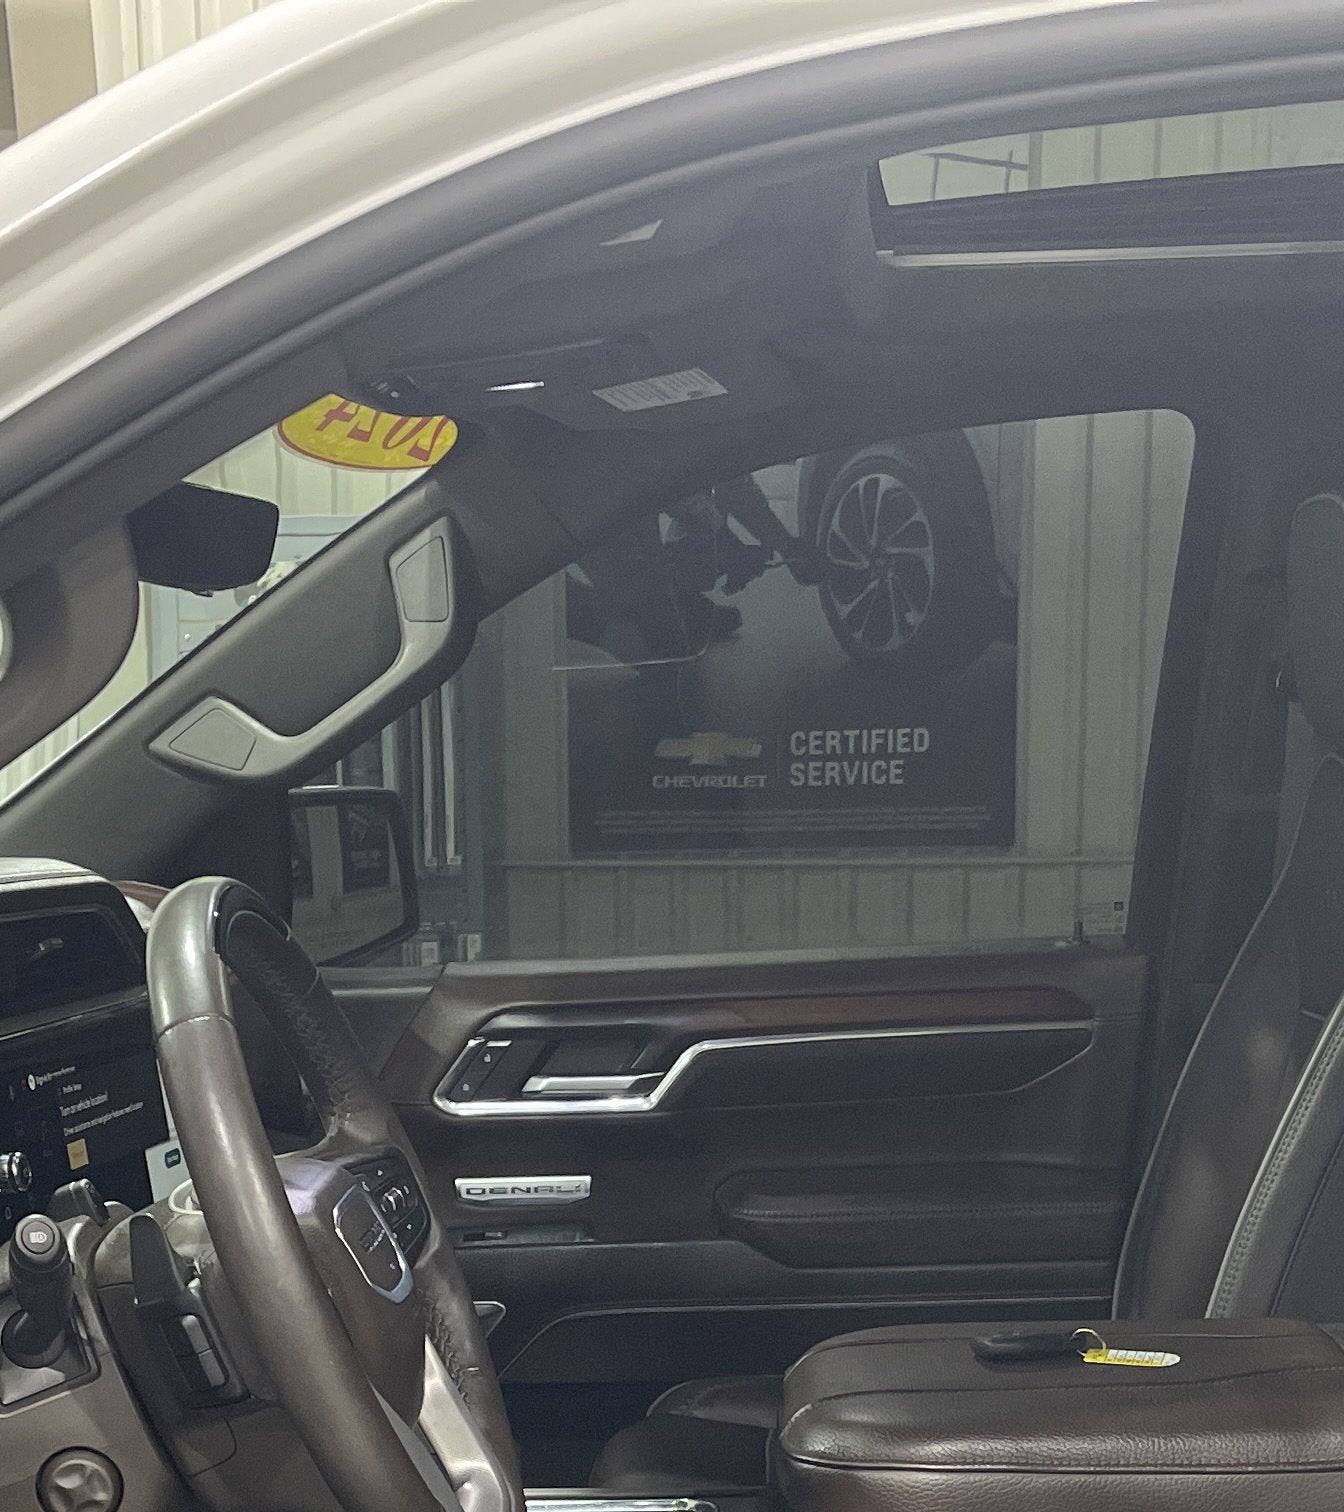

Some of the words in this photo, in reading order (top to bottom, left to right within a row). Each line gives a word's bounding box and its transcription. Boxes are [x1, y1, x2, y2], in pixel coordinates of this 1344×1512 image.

[789, 727, 930, 756] CERTIFIED
[652, 774, 768, 788] CHEVROLET
[789, 759, 905, 787] SERVICE
[465, 1185, 582, 1196] DENALI
